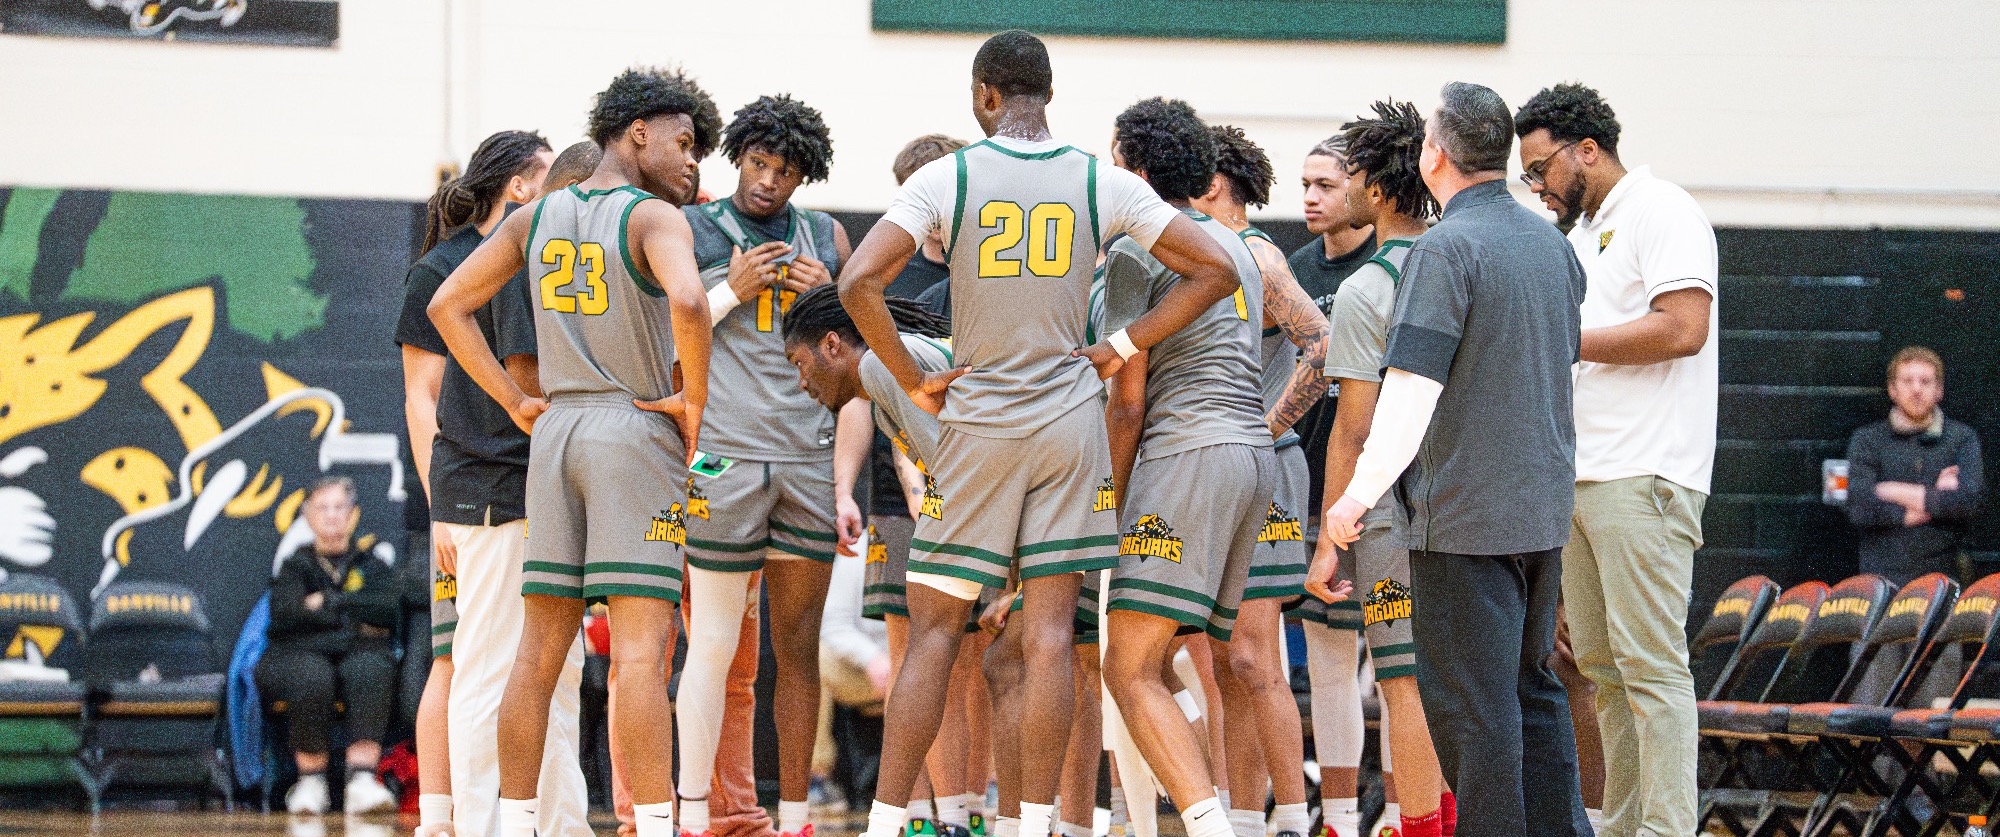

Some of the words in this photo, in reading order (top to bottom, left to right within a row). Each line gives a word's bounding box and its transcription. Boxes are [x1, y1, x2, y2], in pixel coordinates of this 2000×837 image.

[978, 200, 1076, 279] 20
[540, 238, 609, 316] 23
[1364, 600, 1412, 627] JAGUAR
[1819, 597, 1871, 618] DANVILLE
